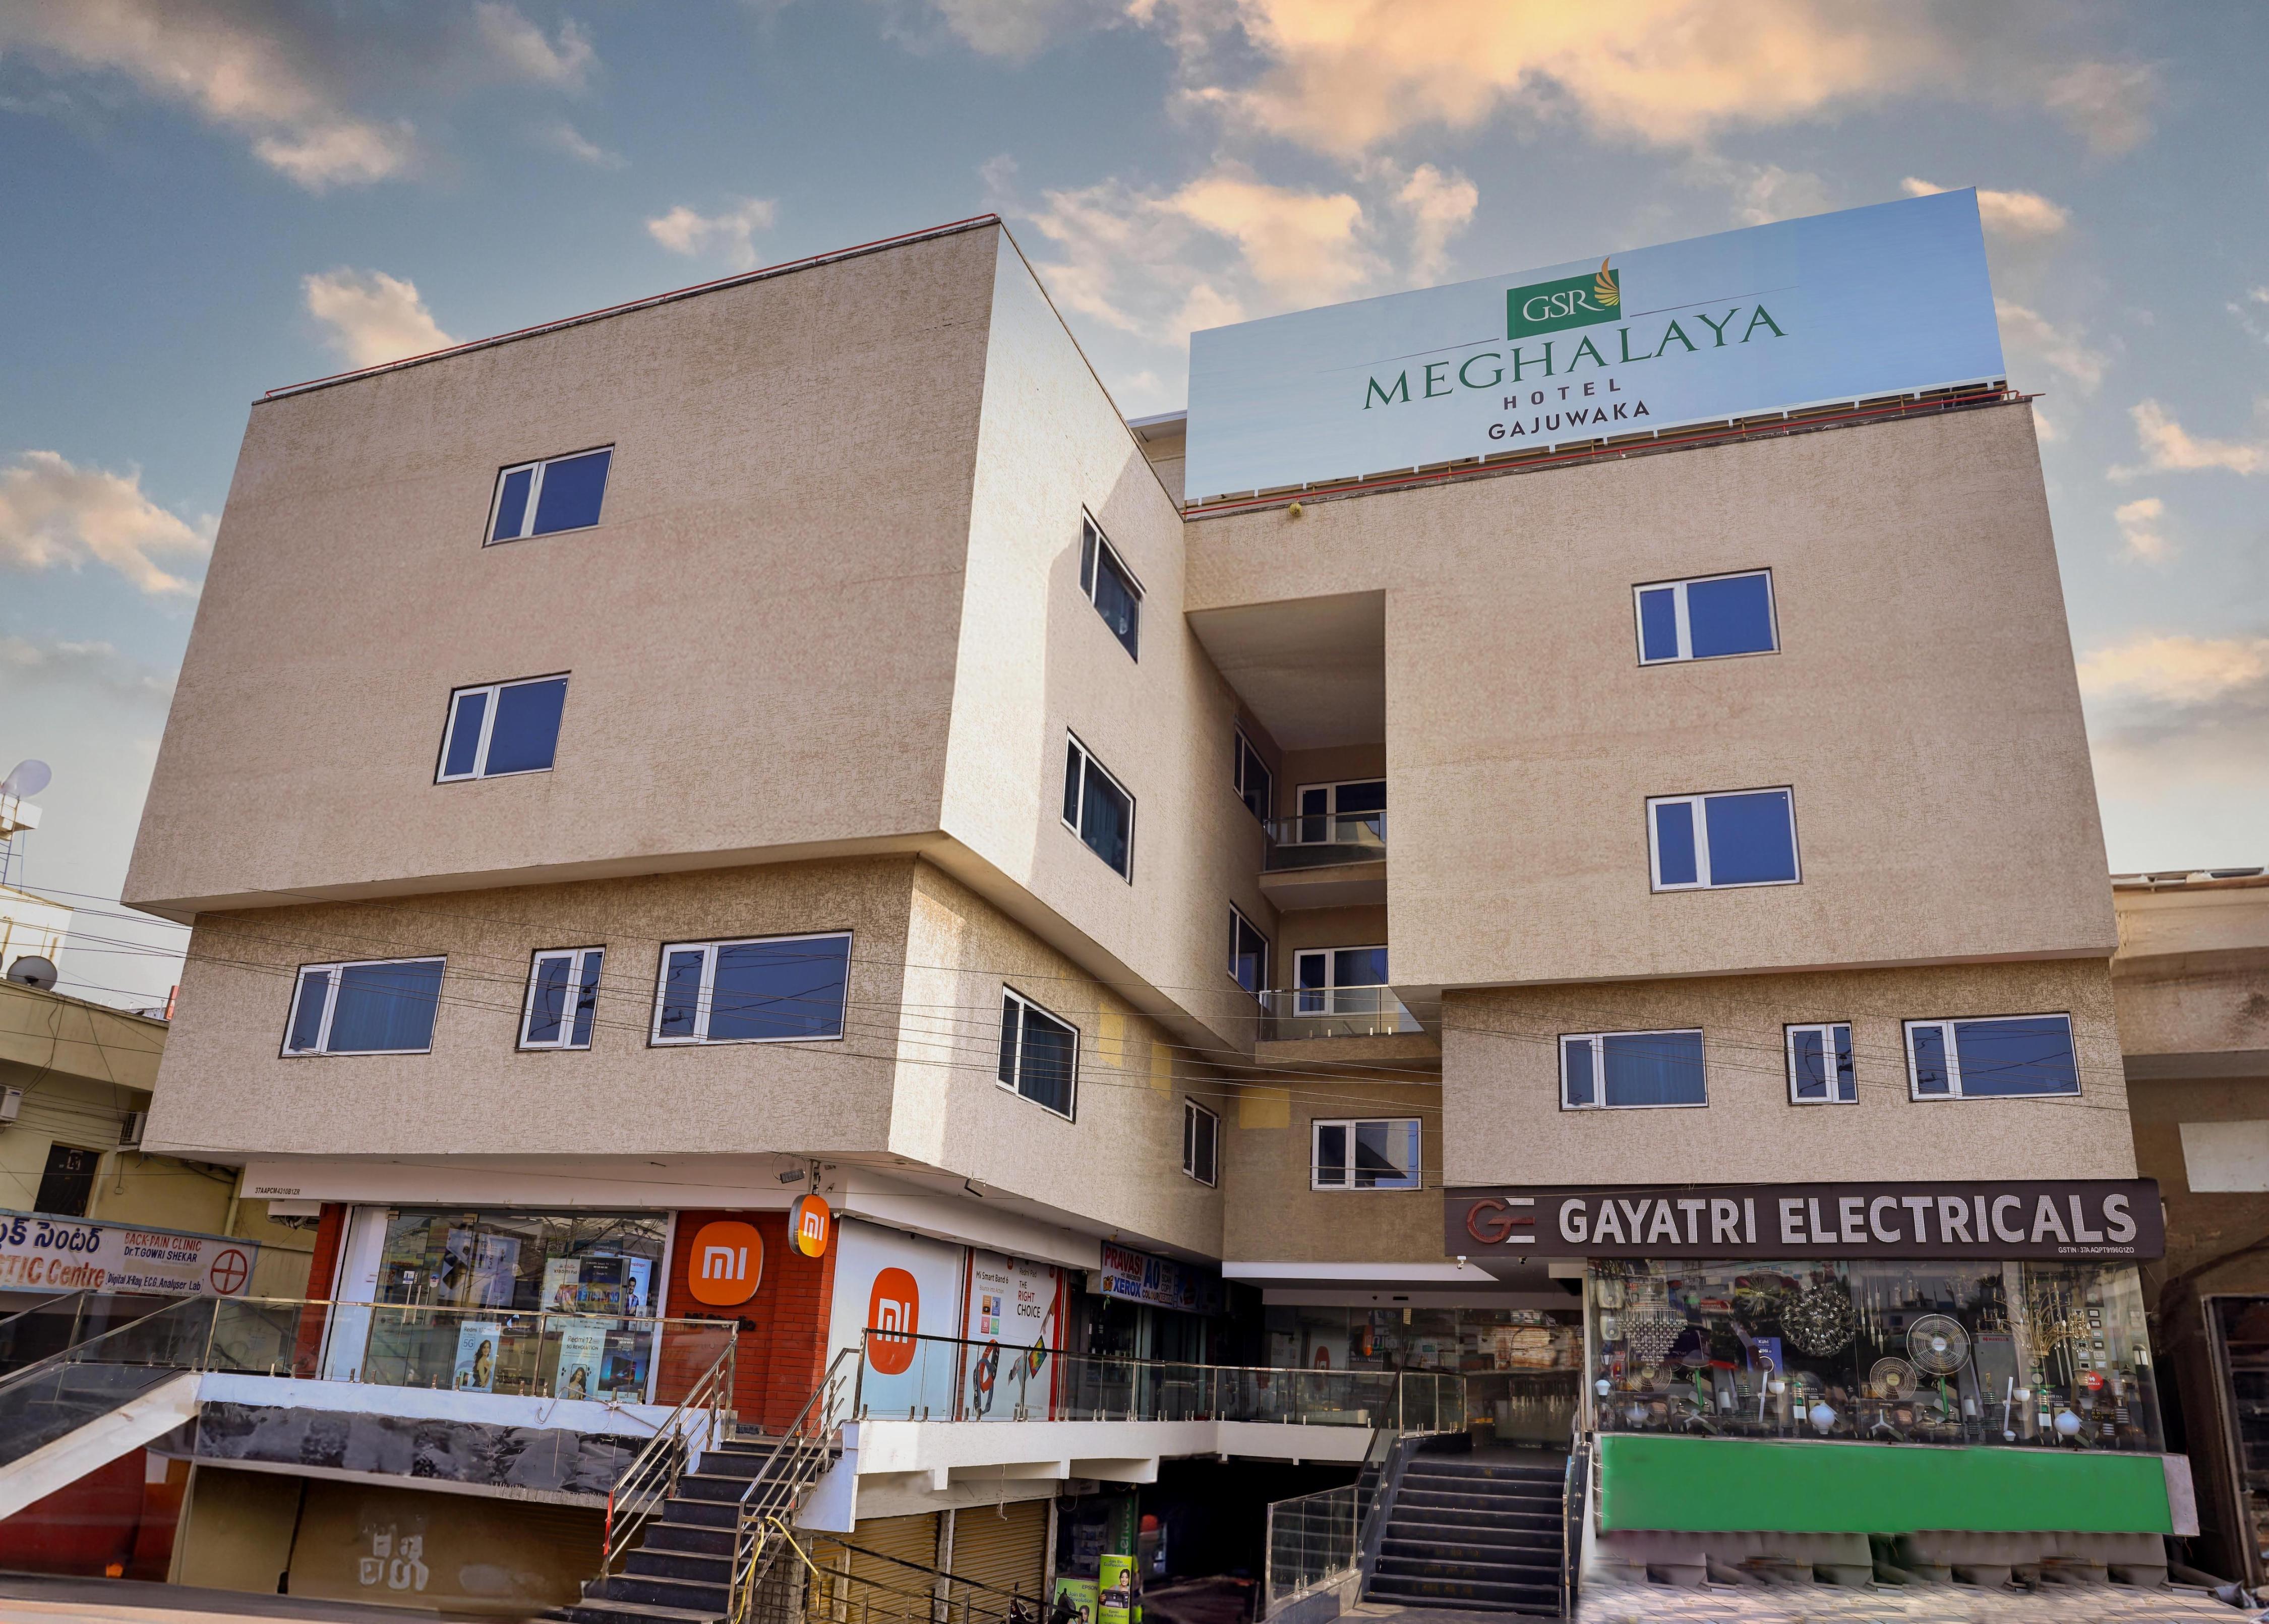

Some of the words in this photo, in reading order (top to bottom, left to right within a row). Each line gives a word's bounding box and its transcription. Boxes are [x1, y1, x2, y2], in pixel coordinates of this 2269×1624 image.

[1523, 289, 1605, 322] GSR
[1362, 304, 1789, 410] MEGHALAYA
[1503, 378, 1621, 410] HOTEL
[1487, 400, 1650, 440] GAJUWAKA
[1559, 1198, 1757, 1244] GAYATRI
[1778, 1193, 2137, 1244] ELECTRICALS
[172, 1237, 202, 1252] CLINIC
[166, 1250, 198, 1262] SHEKAR
[1104, 1246, 1143, 1276] PRAVASI
[46, 1258, 105, 1288] Centre
[976, 1271, 982, 1279] Mi
[982, 1272, 994, 1282] Smart
[995, 1274, 1005, 1284] Band
[1019, 1268, 1030, 1276] Redmi
[1161, 1274, 1172, 1284] SCAN
[158, 1278, 187, 1291] Analyser
[1019, 1280, 1027, 1289] THE
[1113, 1276, 1142, 1298] XEROX
[1161, 1283, 1171, 1293] COPY
[1018, 1290, 1035, 1302] RIGHT
[1142, 1289, 1159, 1302] COLOUR
[1159, 1293, 1173, 1304] XEROX
[1017, 1304, 1041, 1318] CHOICE
[463, 1338, 474, 1348] 5G
